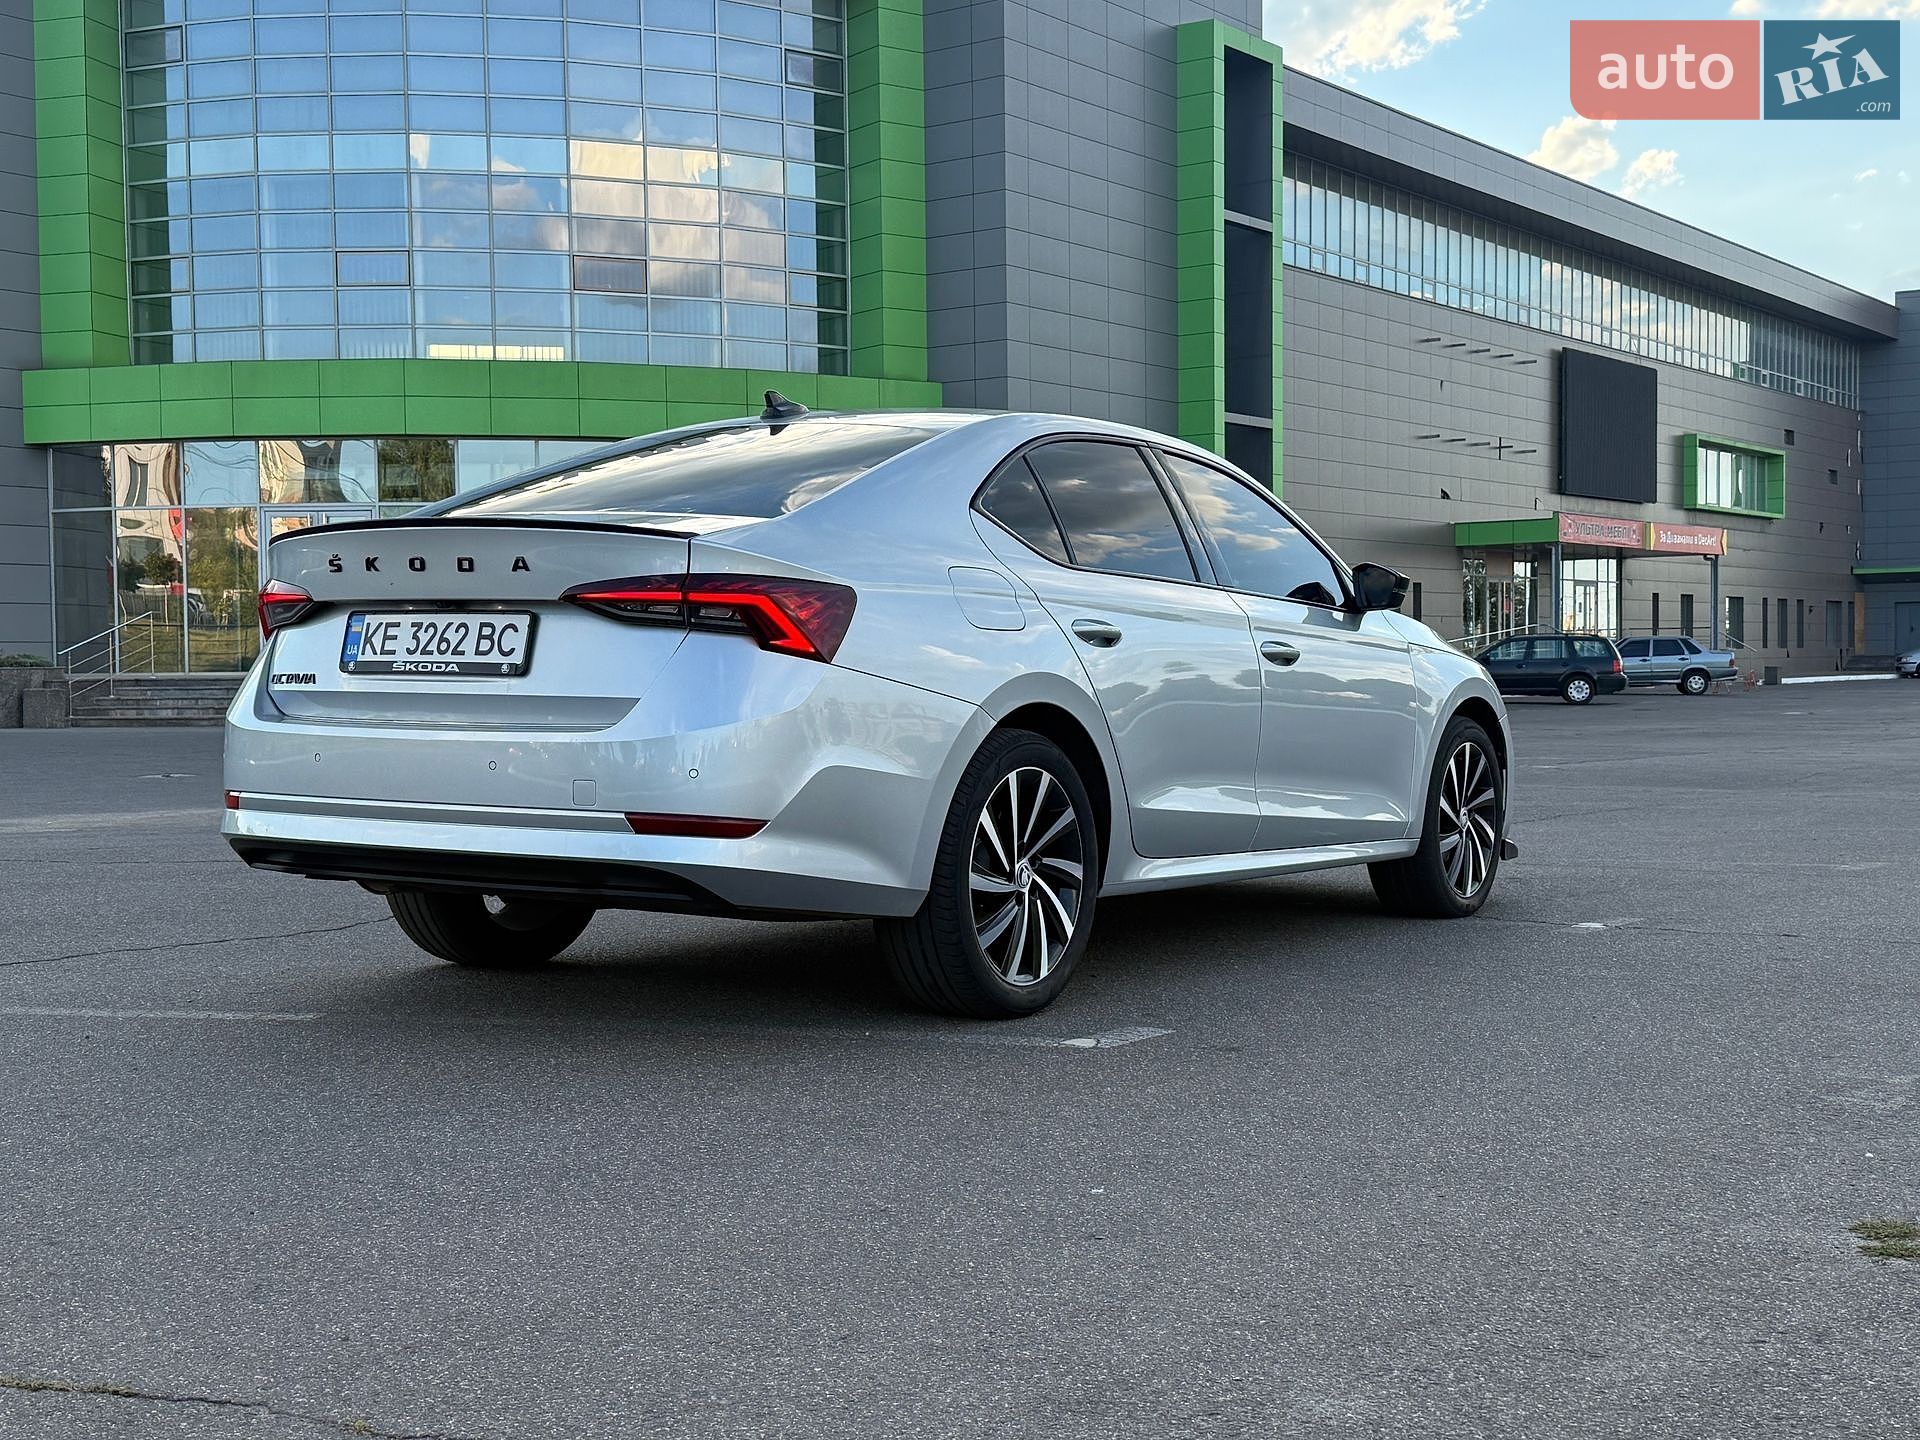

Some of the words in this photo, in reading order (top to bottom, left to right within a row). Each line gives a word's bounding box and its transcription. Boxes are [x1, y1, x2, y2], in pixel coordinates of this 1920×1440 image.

[328, 554, 531, 573] ŠKODA
[360, 621, 401, 656] KE
[405, 621, 470, 656] 3262
[474, 622, 519, 657] BC
[347, 644, 358, 656] UA
[392, 660, 460, 673] ŠKODA
